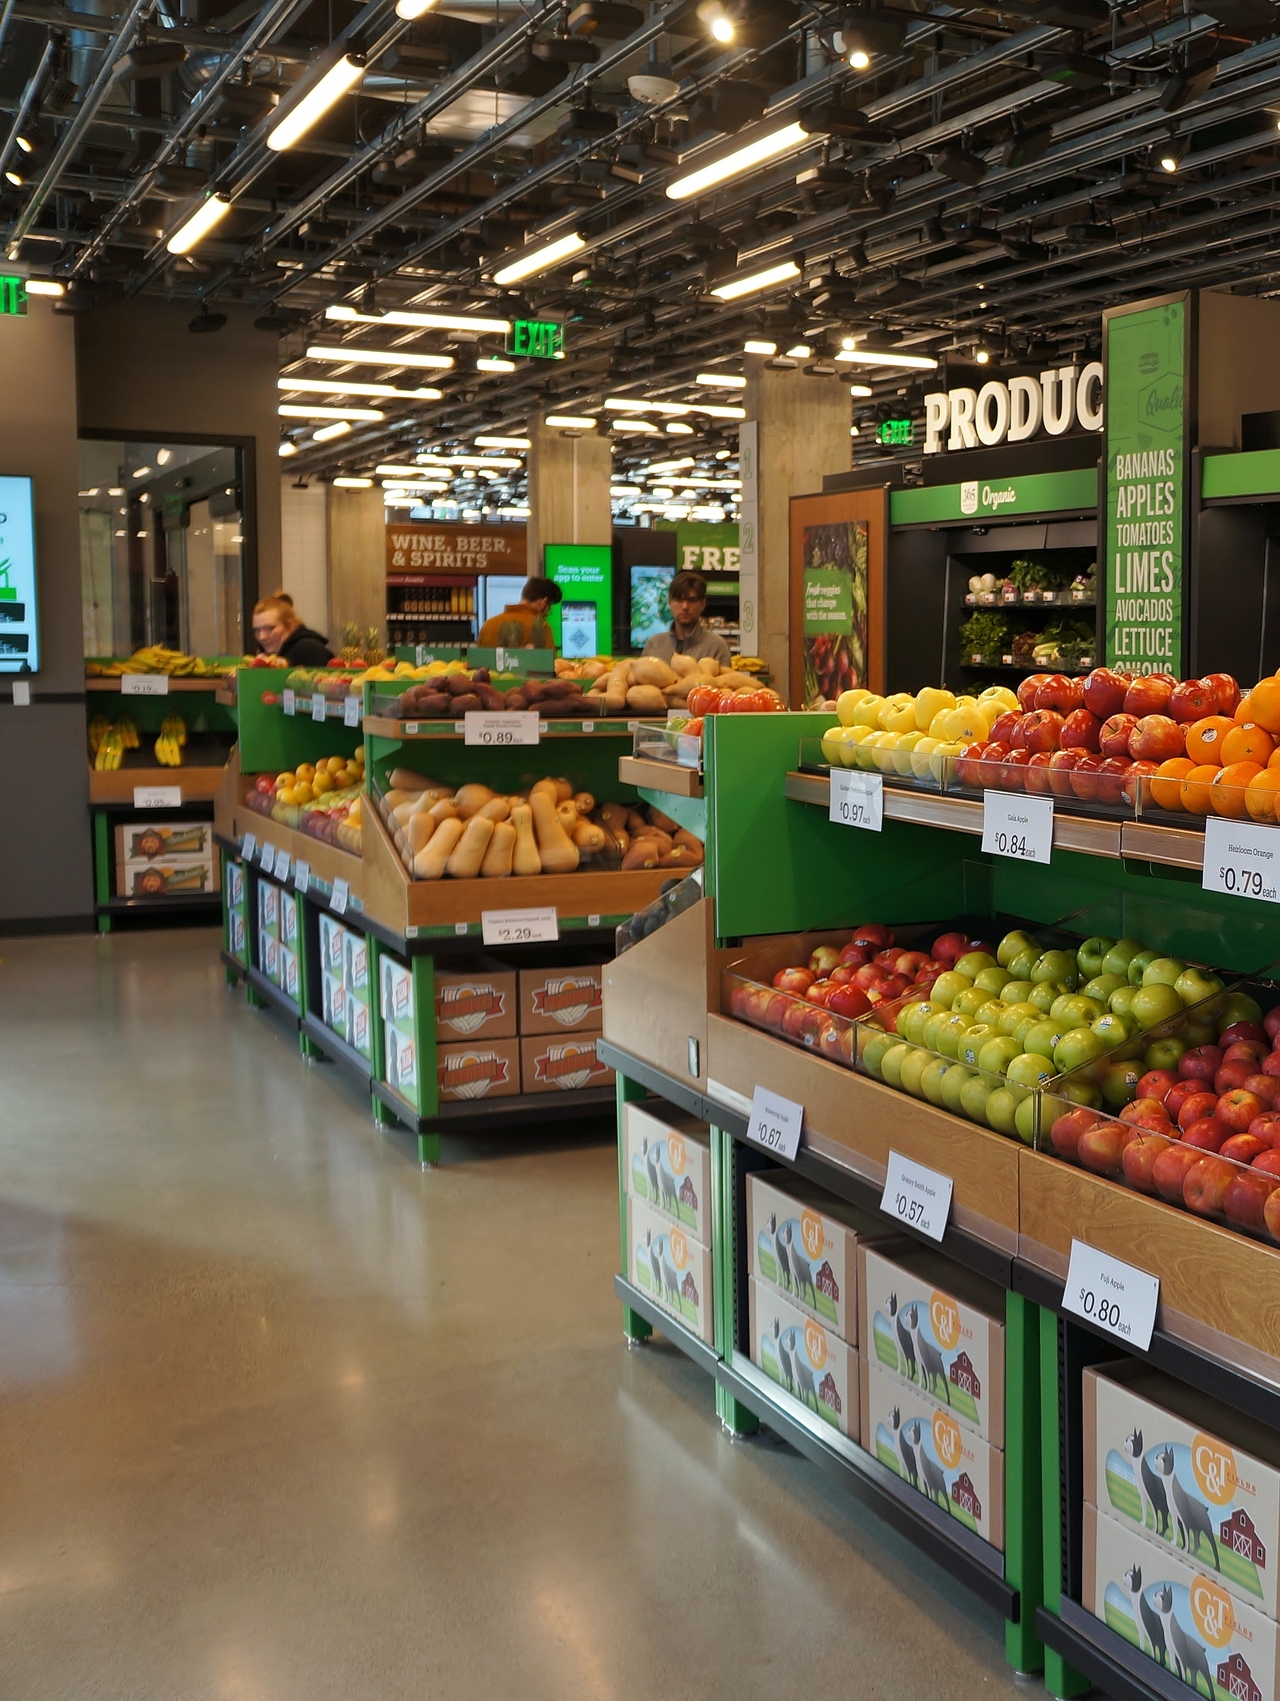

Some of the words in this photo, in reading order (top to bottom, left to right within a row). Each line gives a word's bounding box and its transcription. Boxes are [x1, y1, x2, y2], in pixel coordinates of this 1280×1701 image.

[514, 320, 557, 357] EXIT
[1116, 448, 1174, 481] BANANAS
[982, 486, 1017, 510] Organic
[1117, 481, 1174, 518] APPLES
[391, 534, 451, 552] WINE,
[456, 536, 511, 554] BEER,
[1116, 520, 1174, 547] TOMATOES
[391, 551, 406, 566] &
[410, 551, 487, 568] SPIRITS
[1115, 550, 1174, 593] LIMES
[1115, 598, 1173, 622] AVOCADOS
[1115, 627, 1173, 656] LETTUCE
[994, 831, 1026, 856] $0.84
[1228, 844, 1252, 855] Heirloom
[1252, 848, 1274, 859] Orange
[1219, 866, 1262, 896] $0.79
[894, 1192, 925, 1224] $0.57
[803, 1217, 821, 1254] C&T
[1100, 1272, 1110, 1285] Fuji
[1109, 1278, 1125, 1291] Apple
[932, 1301, 956, 1343] C&T
[1079, 1287, 1121, 1327] $0.80
[935, 1420, 958, 1462] C&T
[1195, 1445, 1231, 1497] C&T
[1194, 1587, 1229, 1639] C&T
